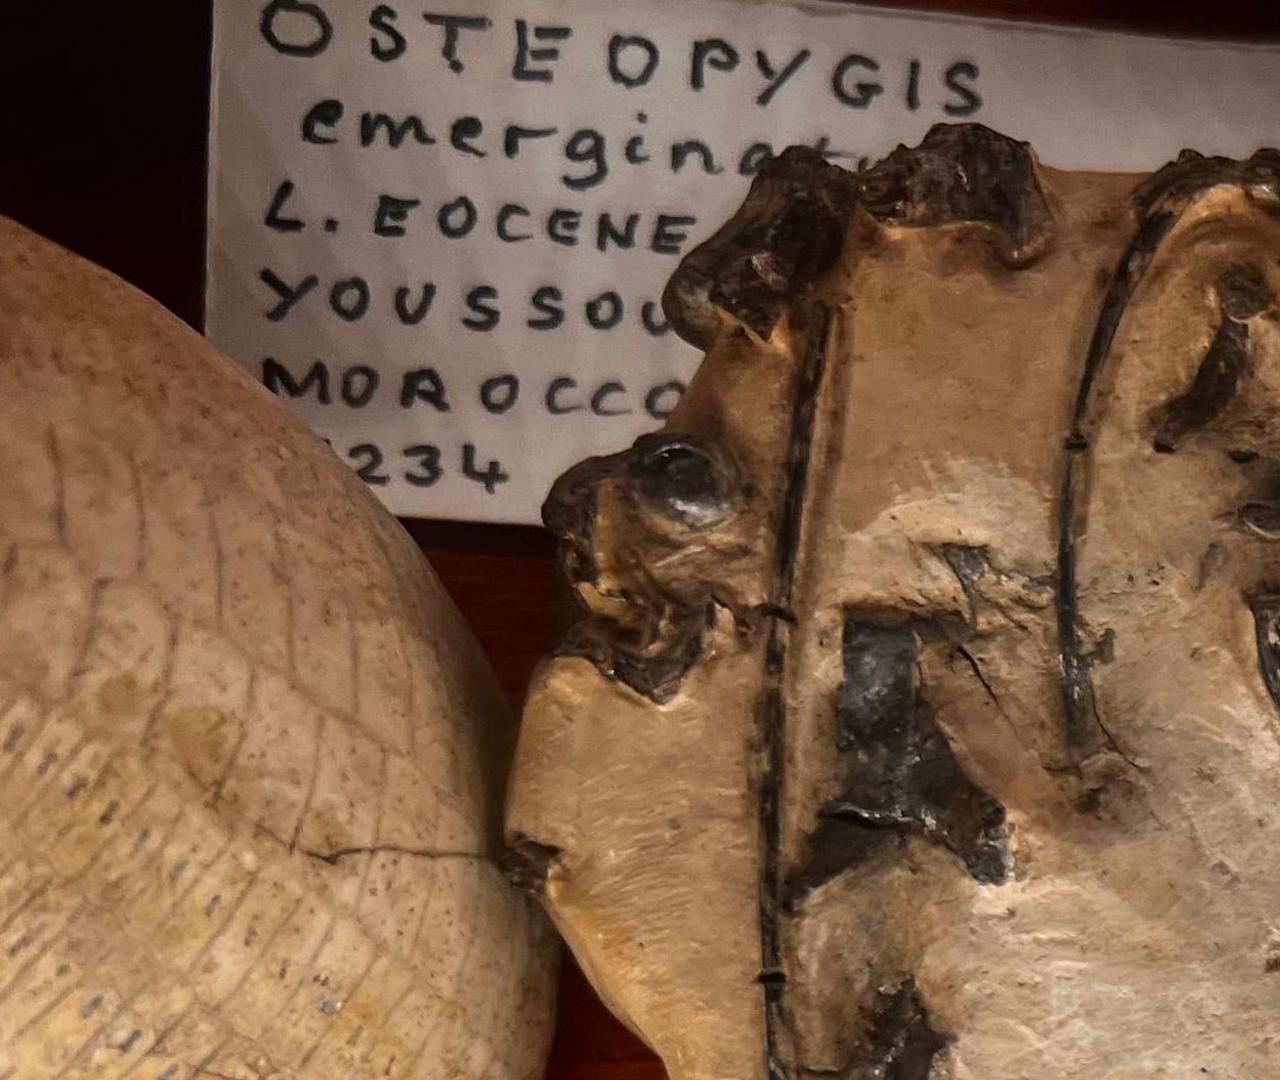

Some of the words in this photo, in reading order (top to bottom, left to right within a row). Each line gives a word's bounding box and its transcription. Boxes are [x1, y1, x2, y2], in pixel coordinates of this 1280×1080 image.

[259, 2, 983, 116] OSTEOPYGIS
[263, 179, 339, 236] L.
[373, 195, 699, 256] EOCENE
[259, 266, 672, 334] YOUSSOU
[262, 356, 686, 419] MOROCCO
